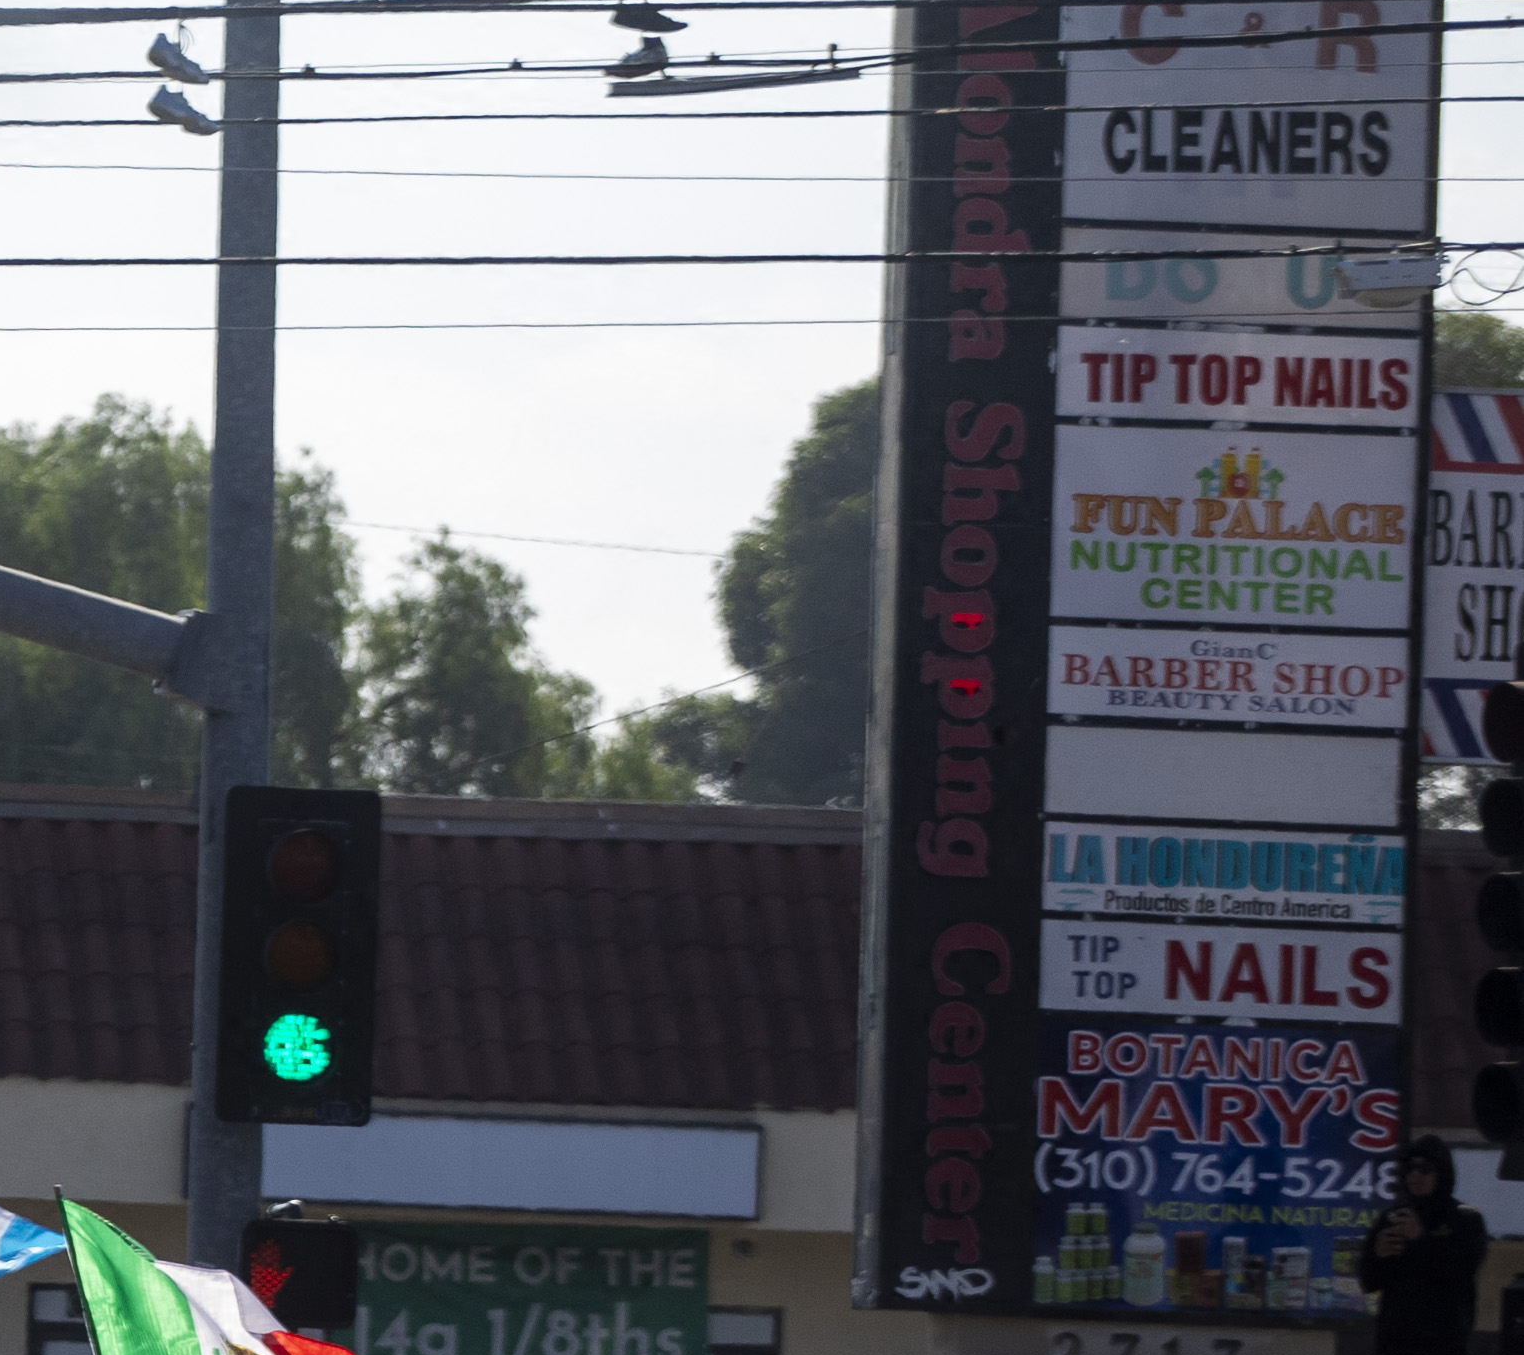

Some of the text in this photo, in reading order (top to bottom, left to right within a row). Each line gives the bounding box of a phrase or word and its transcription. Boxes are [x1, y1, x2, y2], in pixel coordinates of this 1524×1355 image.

[1103, 108, 1392, 177] CLEANERS
[1081, 352, 1409, 411] TIP TOP NAILS
[1071, 493, 1405, 545] FUN PALACE
[1429, 489, 1524, 571] BAR
[1069, 539, 1404, 583] NUTRITIONAL
[1139, 577, 1336, 616] CENTER
[1453, 582, 1524, 663] SH
[916, 399, 1025, 878] Shopping
[1062, 653, 1405, 699] BARBER SHOP
[1107, 689, 1357, 716] BEAUTY SALON
[1047, 832, 1405, 896] LA HONDUREÑA
[1103, 889, 1352, 920] Productos de Centro America
[1066, 934, 1120, 963] TIP
[1164, 939, 1391, 1010] NAILS
[1071, 970, 1139, 1000] TOP
[1068, 1029, 1368, 1085] BOTANICA
[924, 922, 1012, 1264] Center
[1036, 1075, 1400, 1153] MARY'S
[1033, 1143, 1400, 1201] (310) 764-5248
[1142, 1201, 1384, 1229] MEDICINA NATURA
[357, 1242, 696, 1288] HOME OF THE
